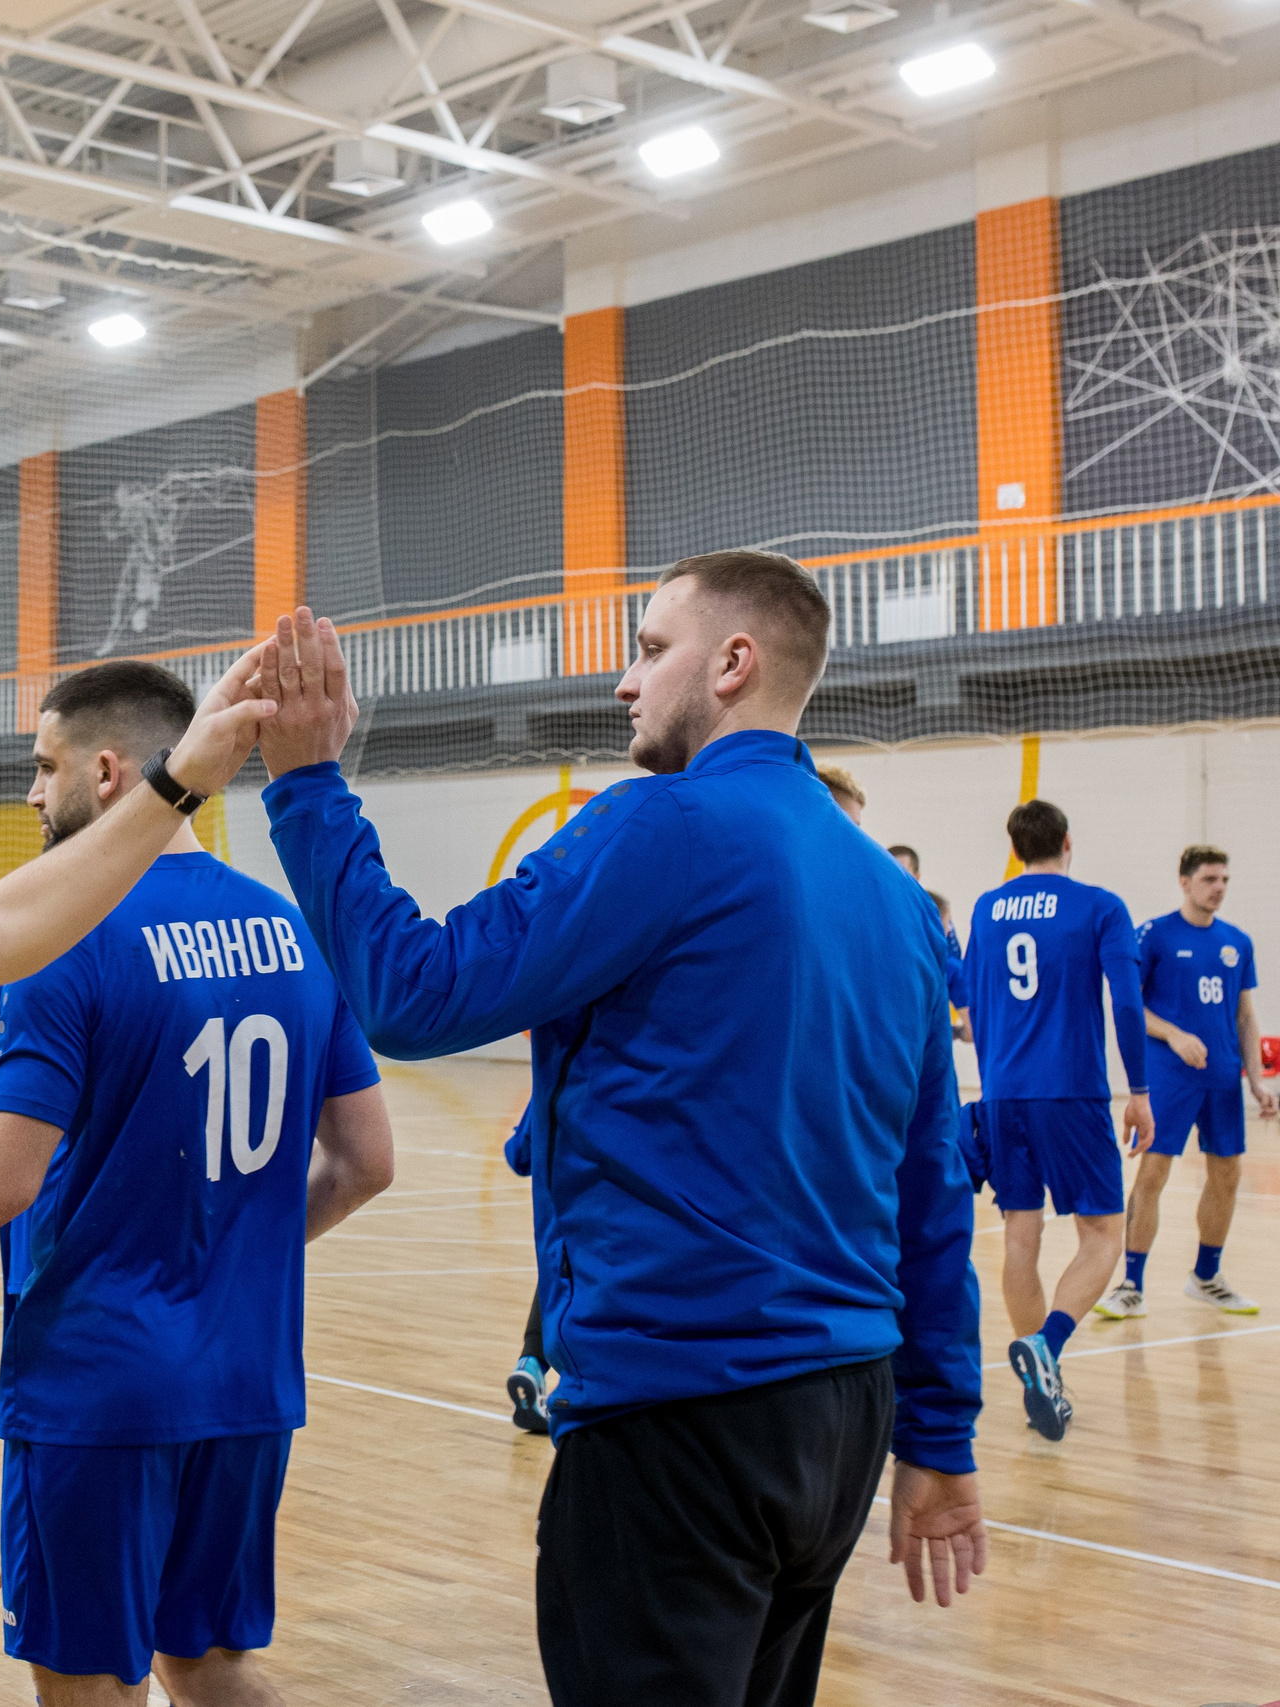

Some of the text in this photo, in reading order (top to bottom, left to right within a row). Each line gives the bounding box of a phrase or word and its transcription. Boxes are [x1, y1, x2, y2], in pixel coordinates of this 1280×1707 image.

[991, 892, 1058, 921] ФИЛЁВ
[141, 916, 304, 982] ИВАНОВ
[1006, 932, 1038, 1001] 9
[1198, 976, 1223, 1004] 66
[182, 1014, 289, 1182] 10
